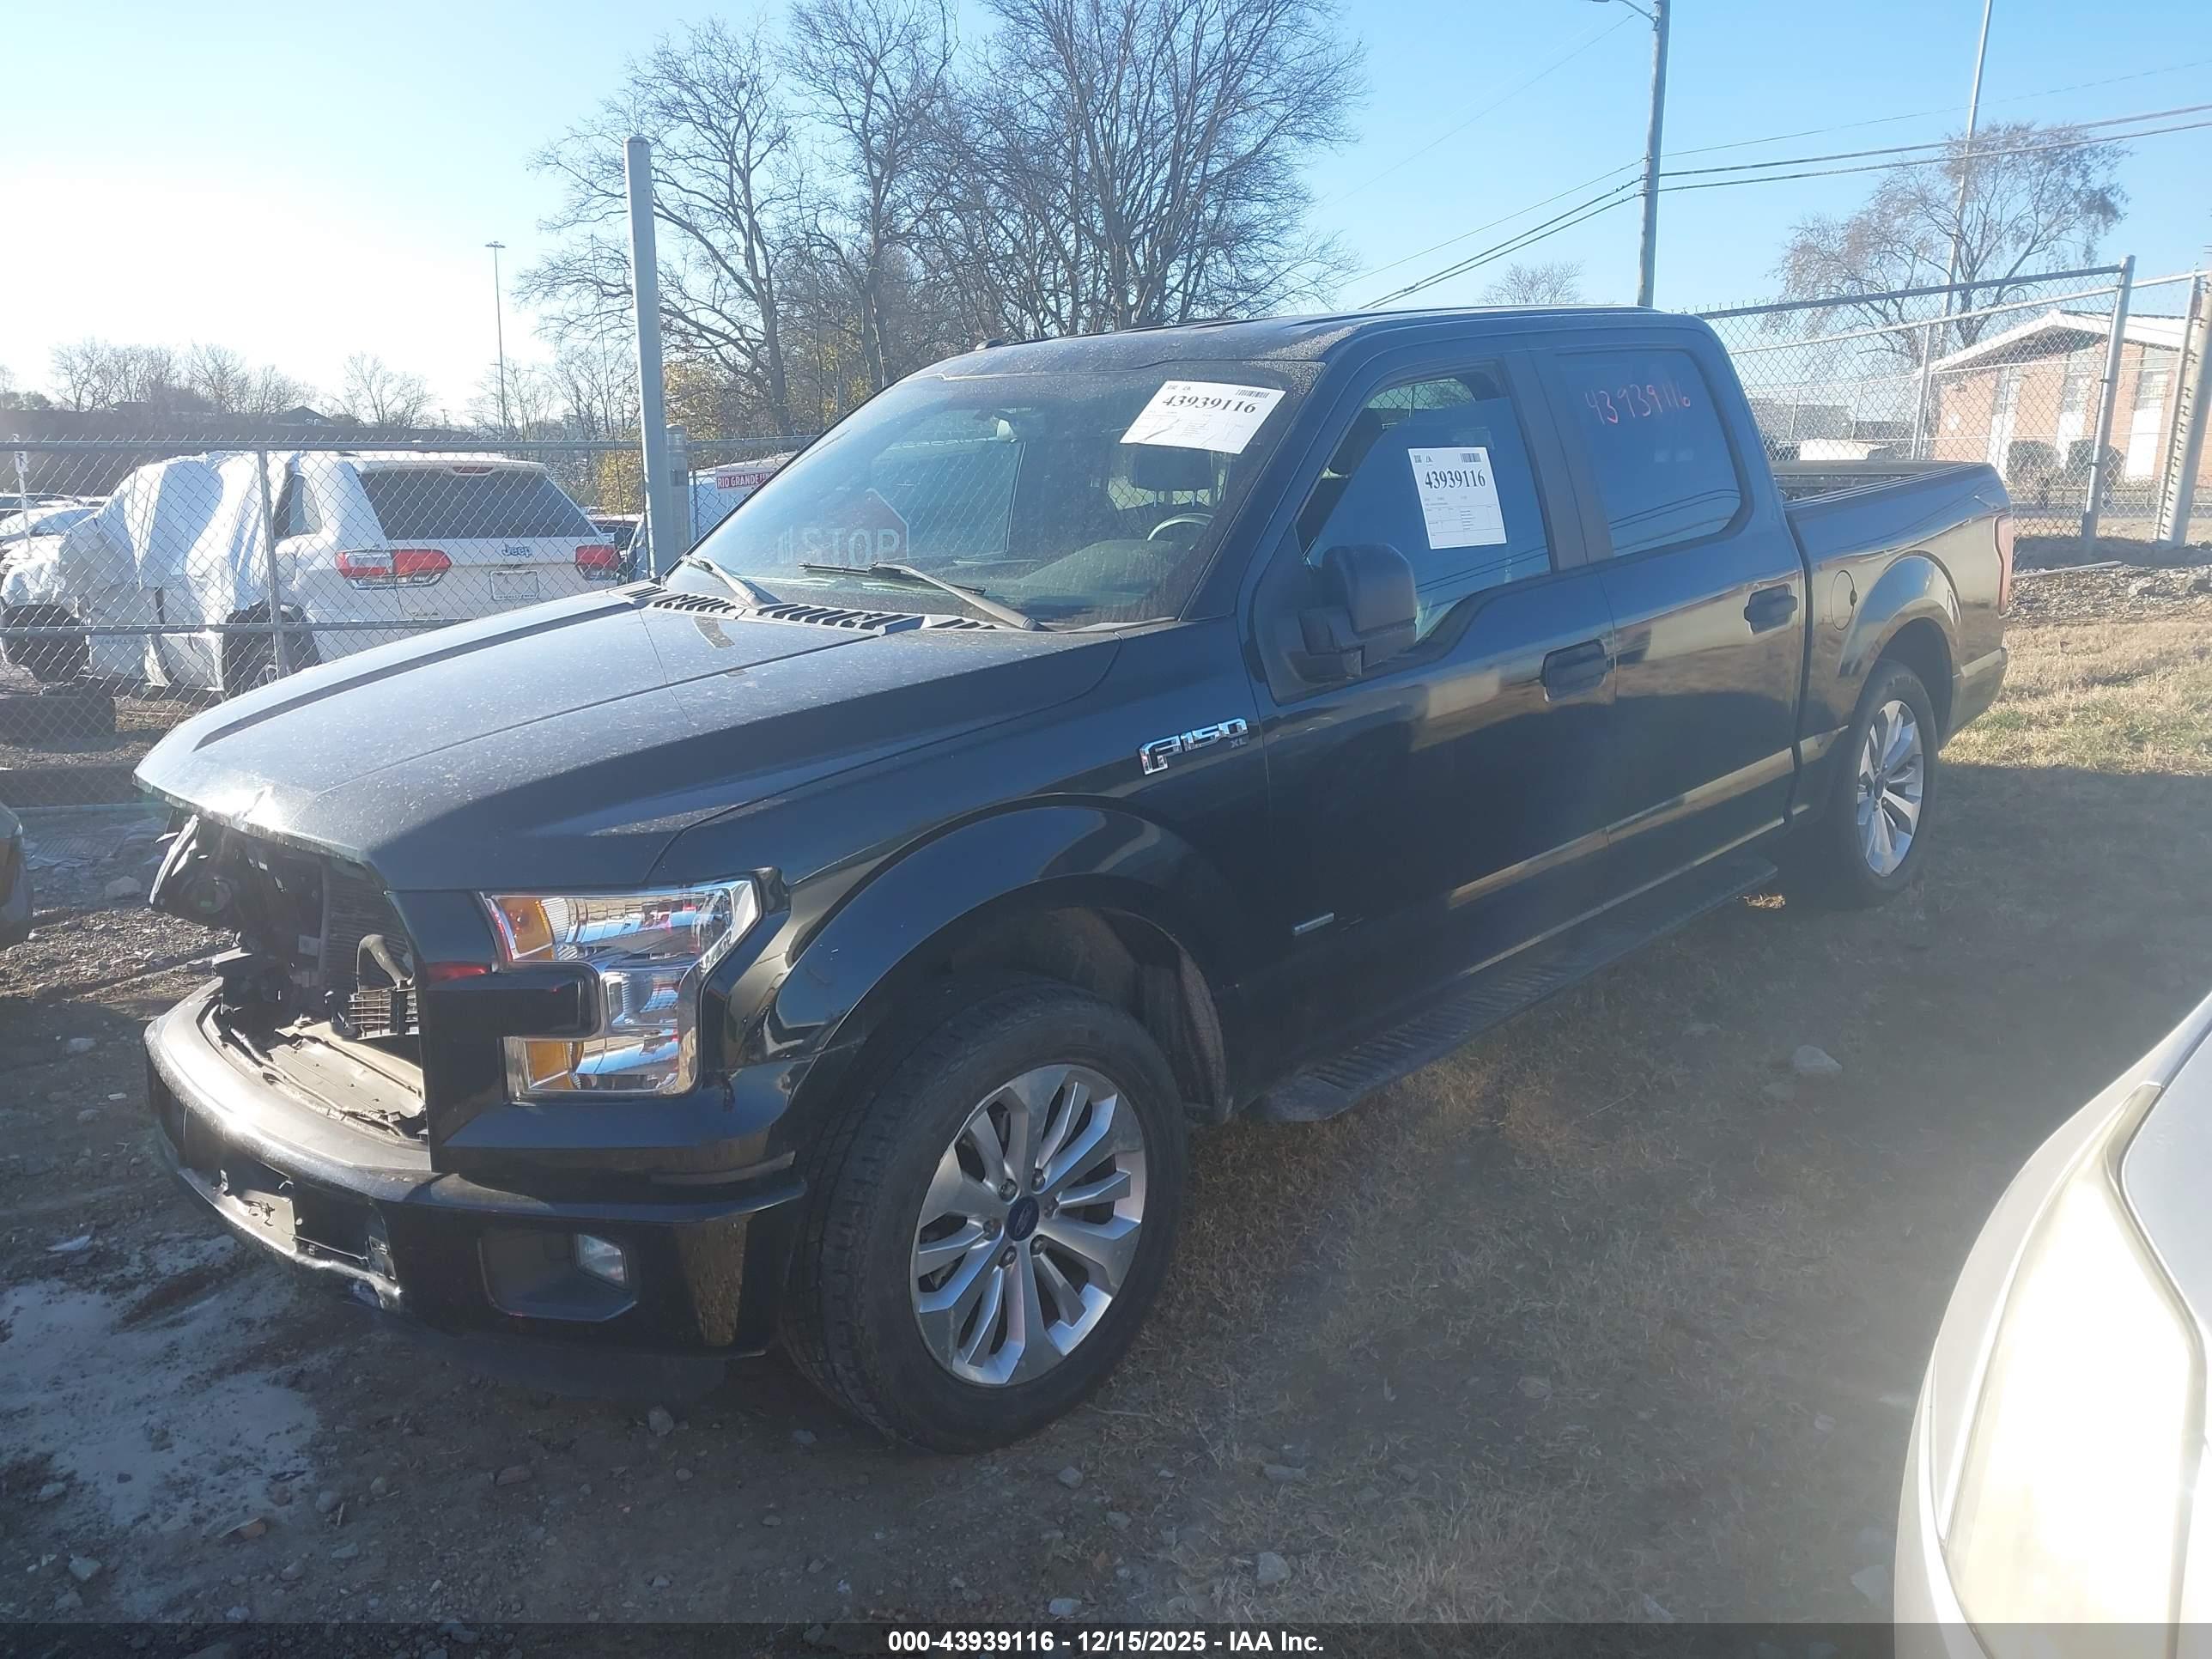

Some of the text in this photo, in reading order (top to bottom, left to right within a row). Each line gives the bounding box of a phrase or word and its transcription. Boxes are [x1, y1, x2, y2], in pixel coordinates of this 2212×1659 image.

[1163, 395, 1261, 414] 43939116
[1585, 381, 1691, 425] 43939116
[717, 477, 730, 489] RIO
[731, 473, 760, 488] GRANDE
[1425, 470, 1486, 489] 43939116
[501, 544, 532, 557] Jeep
[802, 526, 900, 565] STOP
[1230, 738, 1247, 749] XL
